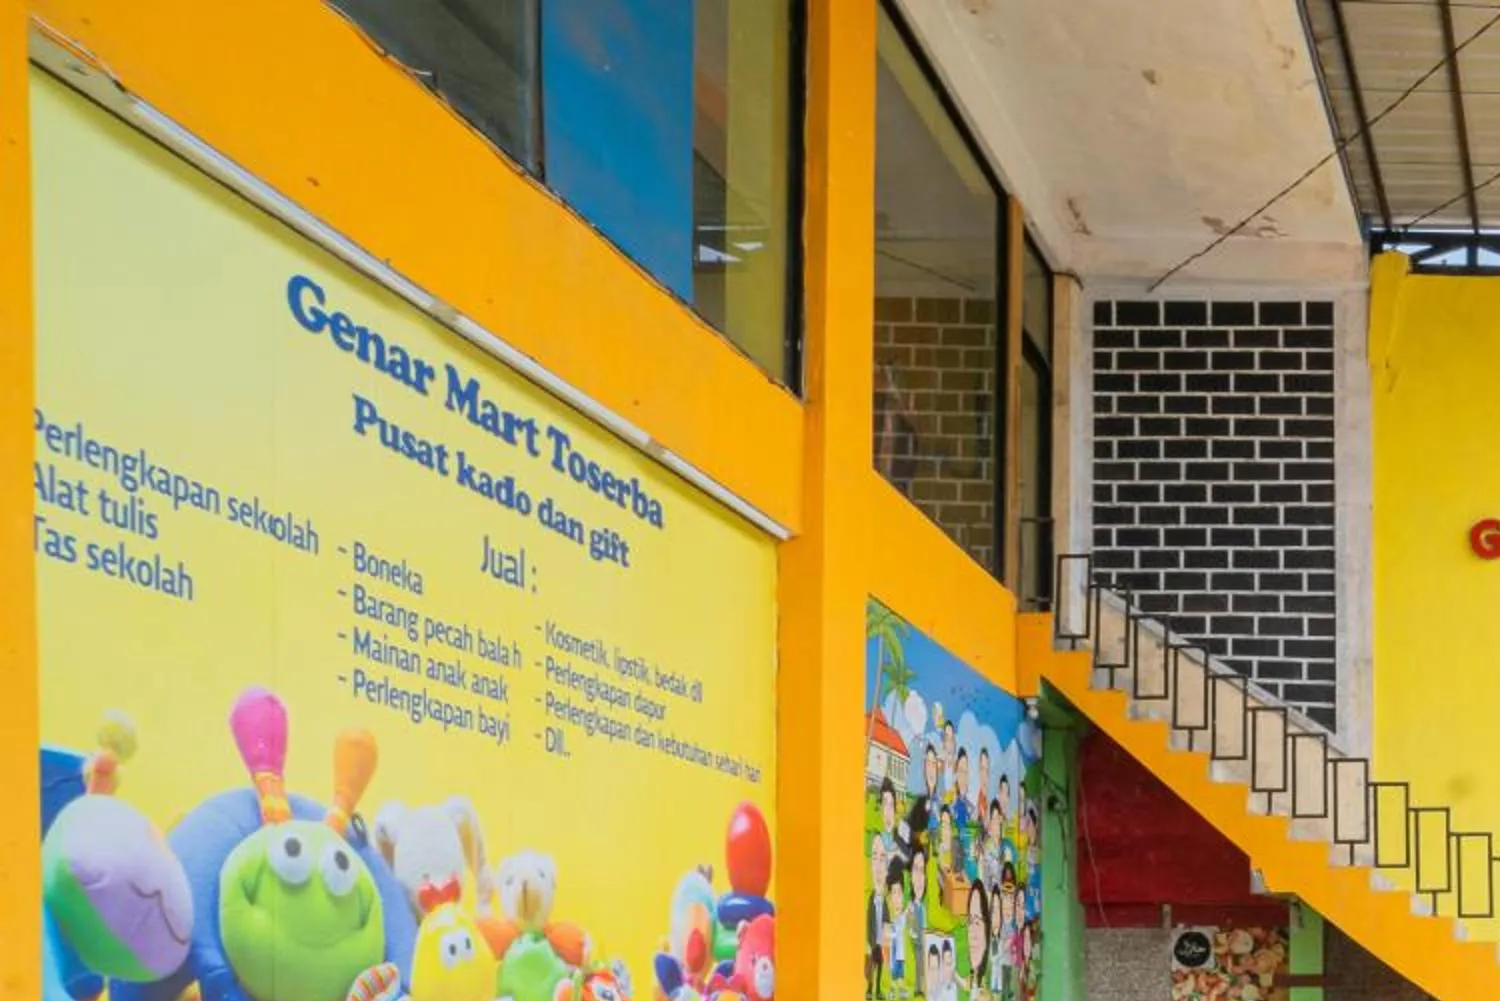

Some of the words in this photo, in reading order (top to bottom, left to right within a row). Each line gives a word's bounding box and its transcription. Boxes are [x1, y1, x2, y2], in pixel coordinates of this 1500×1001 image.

[286, 274, 435, 397] Genar
[444, 363, 541, 458] Mart
[546, 425, 664, 530] Toserba
[352, 393, 449, 477] Pusat
[456, 452, 532, 516] kado
[537, 499, 584, 545] dan
[590, 528, 630, 568] gift
[98, 489, 158, 540] tulis
[87, 541, 193, 601] sekolah
[353, 541, 424, 595] Boneka
[480, 535, 525, 588] Jual
[353, 583, 419, 642] Barang
[424, 617, 473, 653] pecah
[353, 626, 421, 675] Mainan
[426, 658, 467, 689] anak
[471, 672, 509, 704] anak
[545, 655, 631, 710] Perlengkapan
[353, 668, 473, 732] Perlengkapan
[479, 704, 510, 746] bayi
[545, 691, 631, 743] Perlengkapan
[634, 722, 655, 748] dan
